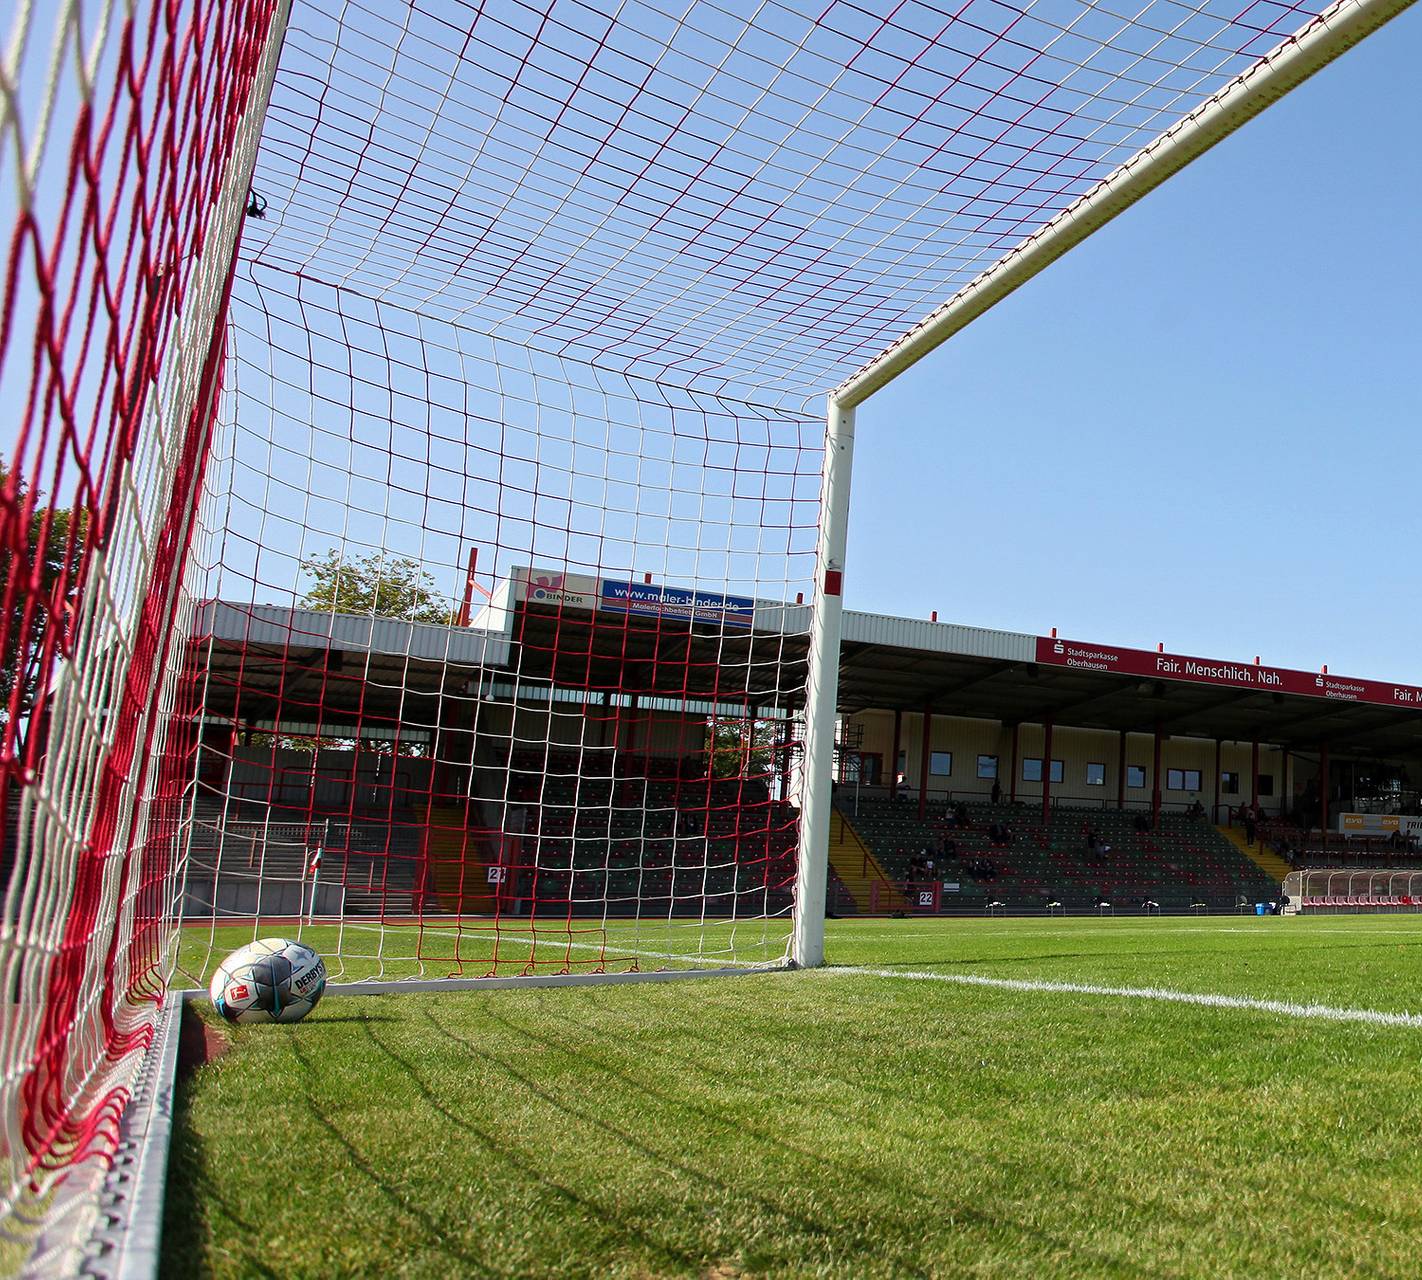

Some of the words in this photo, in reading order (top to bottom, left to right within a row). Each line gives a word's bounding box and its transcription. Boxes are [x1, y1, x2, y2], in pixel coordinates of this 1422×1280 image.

[546, 592, 583, 604] BINDER
[1067, 647, 1119, 663] Stadtsparkasse
[1066, 659, 1108, 671] Oberhausen
[1156, 658, 1182, 674] Fair.
[1185, 664, 1254, 682] Menschlich.
[1257, 671, 1283, 686] Nah.
[1325, 680, 1365, 693] Stadtsparkasse
[1325, 690, 1358, 700] Oberhausen
[1393, 688, 1413, 702] Fair.
[920, 893, 932, 903] 22
